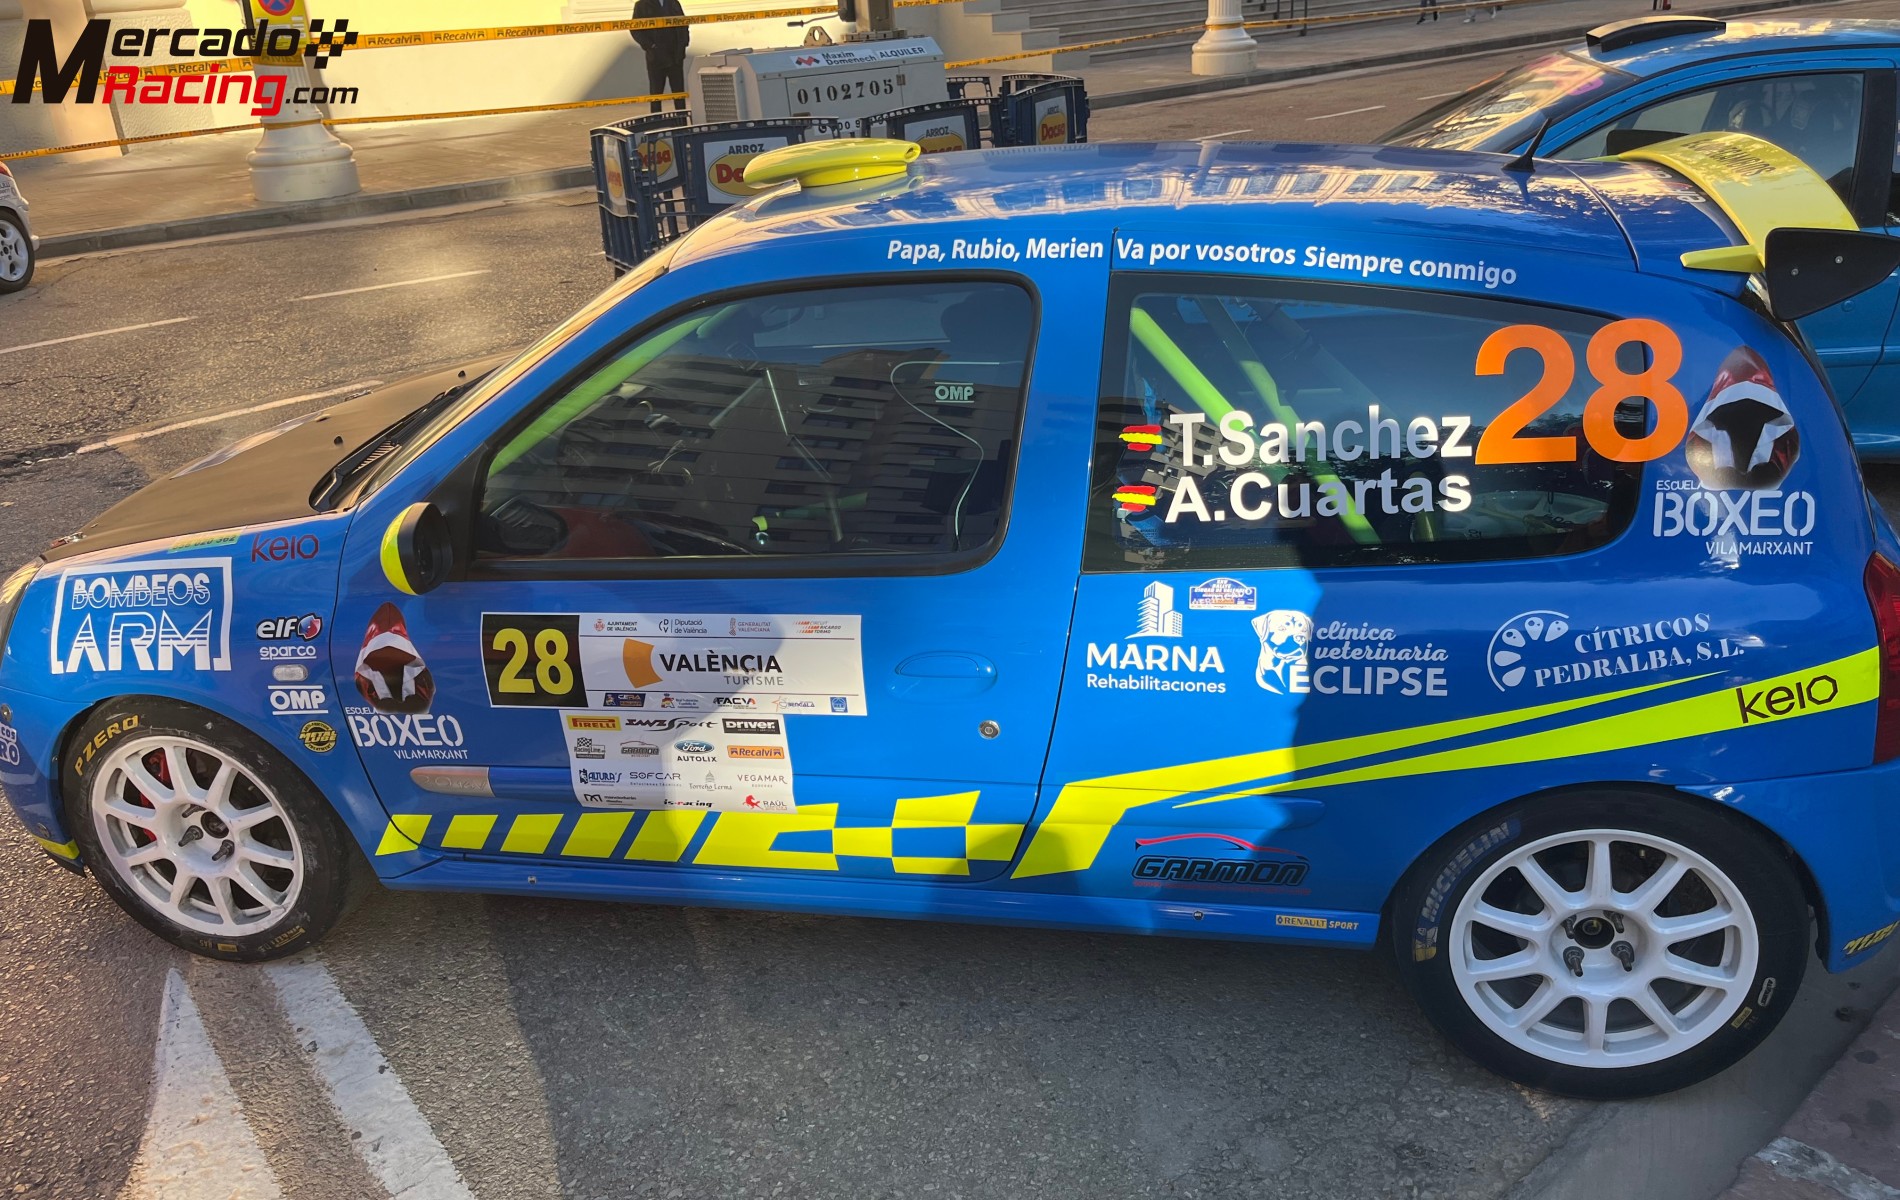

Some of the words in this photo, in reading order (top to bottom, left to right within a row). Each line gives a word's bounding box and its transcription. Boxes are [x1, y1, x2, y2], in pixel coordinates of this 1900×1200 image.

[377, 33, 413, 45] Recalvi
[443, 31, 477, 41] Recalvi
[505, 27, 537, 37] Recalvi
[562, 23, 593, 33] Recalvi
[618, 20, 648, 30] Recalvi
[672, 16, 701, 25] Recalvi
[821, 51, 855, 60] Maxim
[879, 47, 926, 58] ALQUILER
[826, 55, 877, 66] Domenech
[797, 79, 894, 104] 0102705
[925, 126, 950, 139] ARROZ
[728, 143, 765, 155] ARROZ
[887, 240, 946, 264] Papa,
[951, 238, 1021, 263] Rubio,
[1026, 237, 1104, 259] Merien
[1117, 238, 1144, 260] Va
[1150, 244, 1190, 265] por
[1195, 243, 1296, 265] vosotros
[1303, 245, 1404, 277] Siempre
[1409, 260, 1517, 289] conmigo
[935, 384, 975, 400] OMP
[1475, 318, 1689, 465] 28
[1169, 404, 1473, 467] T.Sanchez
[1165, 467, 1472, 524] A.Cuartas
[1653, 490, 1816, 538] BOXEO
[1705, 541, 1814, 556] VILAMARXANT
[71, 572, 211, 610] BOMBEOS
[256, 615, 298, 640] elf
[674, 619, 703, 627] Diputació
[1316, 621, 1397, 642] clínica
[1574, 612, 1711, 654] CÍTRICOS
[66, 609, 215, 673] ARM
[1314, 642, 1449, 662] veterinaria
[259, 645, 316, 660] sparco
[493, 628, 574, 695] 28
[659, 650, 783, 674] VALÈNCIA
[1086, 642, 1226, 674] MARNA
[1533, 646, 1693, 688] PEDRALBA,
[1696, 638, 1745, 662] S.L.
[724, 675, 784, 686] TURISME
[1086, 674, 1227, 693] Rehabilitaciones
[1289, 664, 1449, 697] ECLIPSE
[269, 690, 326, 710] OMP
[347, 714, 464, 747] BOXEO
[572, 717, 617, 729] PIRELLI
[393, 749, 469, 760] VILAMARXANT
[677, 755, 718, 763] AUTOLIX
[682, 741, 708, 752] Ford
[739, 747, 773, 757] Recalvi
[629, 771, 682, 780] SOFCAR
[737, 774, 788, 785] VEGAMAR
[1134, 855, 1310, 887] GARMON
[1420, 821, 1510, 923] MICHELIN
[1283, 916, 1327, 929] RENAULT
[1328, 919, 1359, 930] SPORT
